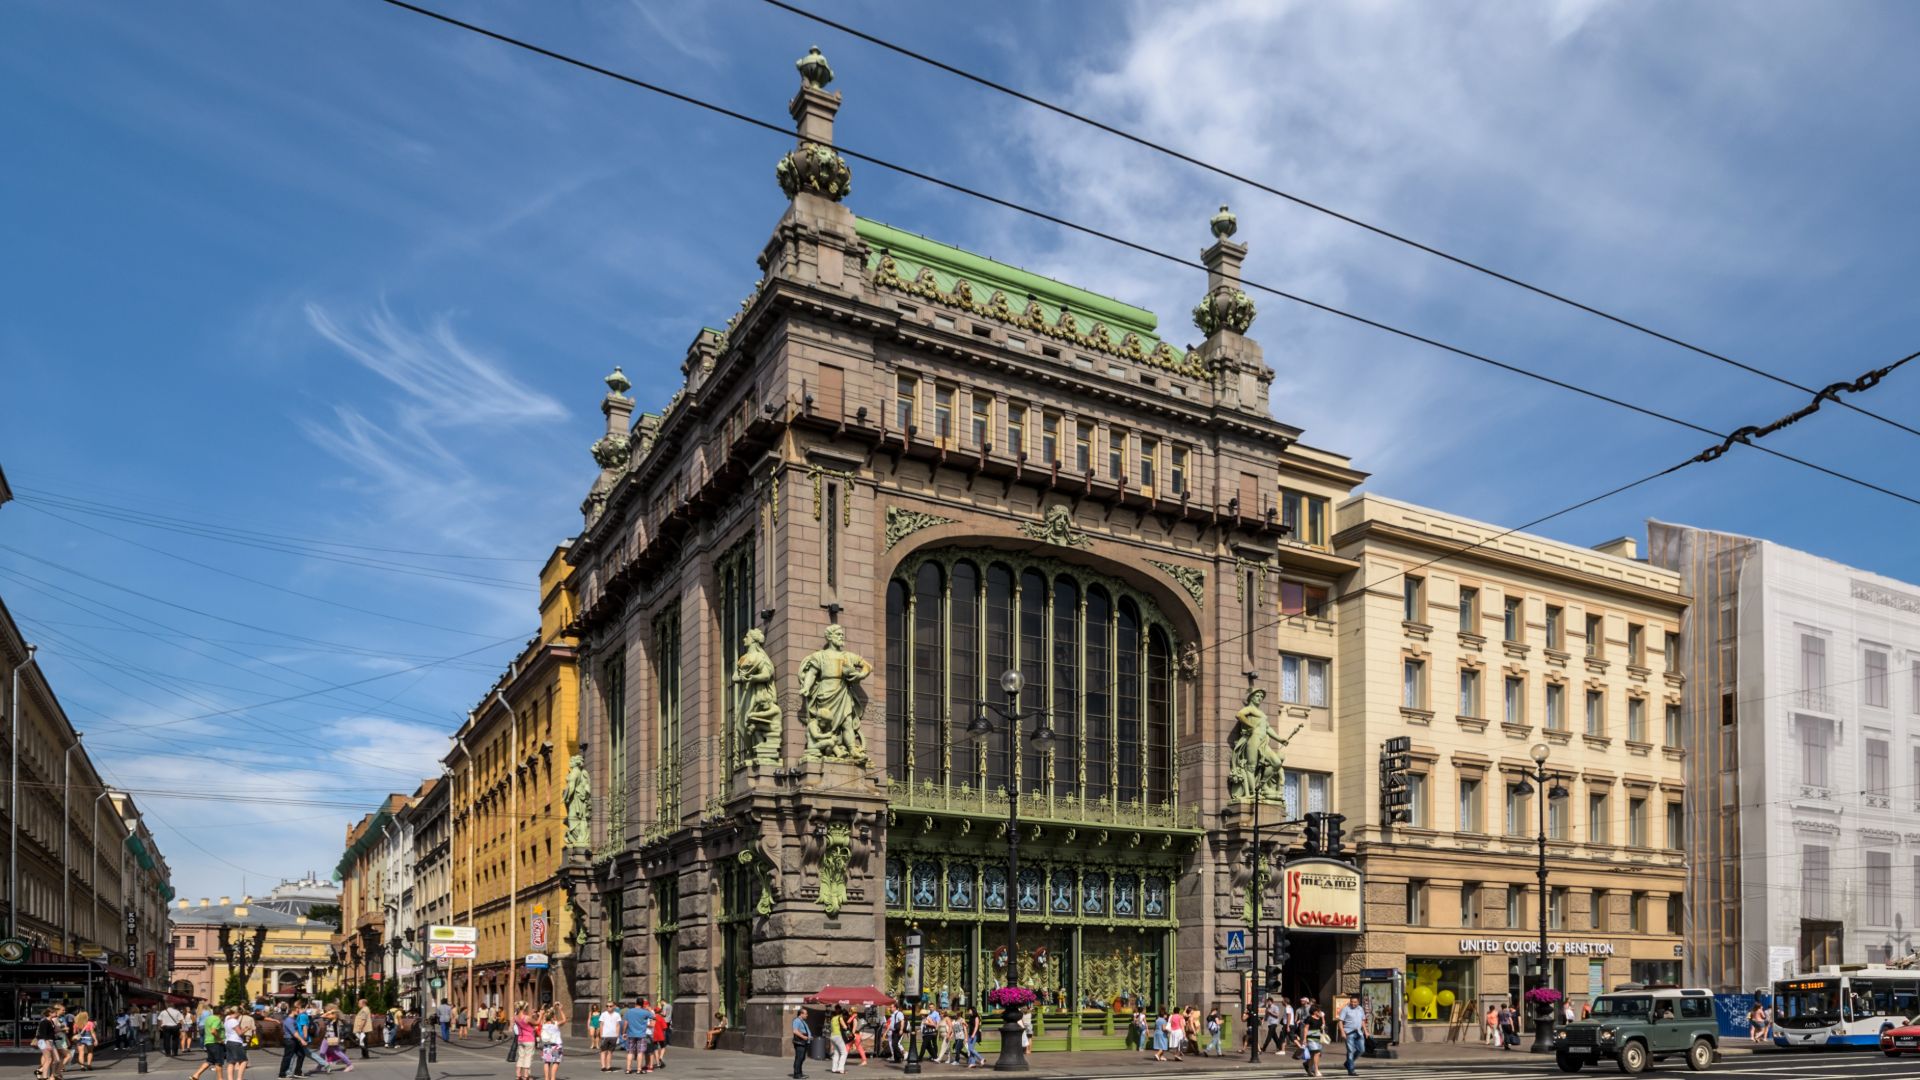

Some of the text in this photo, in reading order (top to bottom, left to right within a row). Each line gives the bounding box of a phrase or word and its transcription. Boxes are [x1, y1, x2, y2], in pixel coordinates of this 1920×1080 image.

[1460, 940, 1614, 955] UNITED COLORS OF BENETTON
